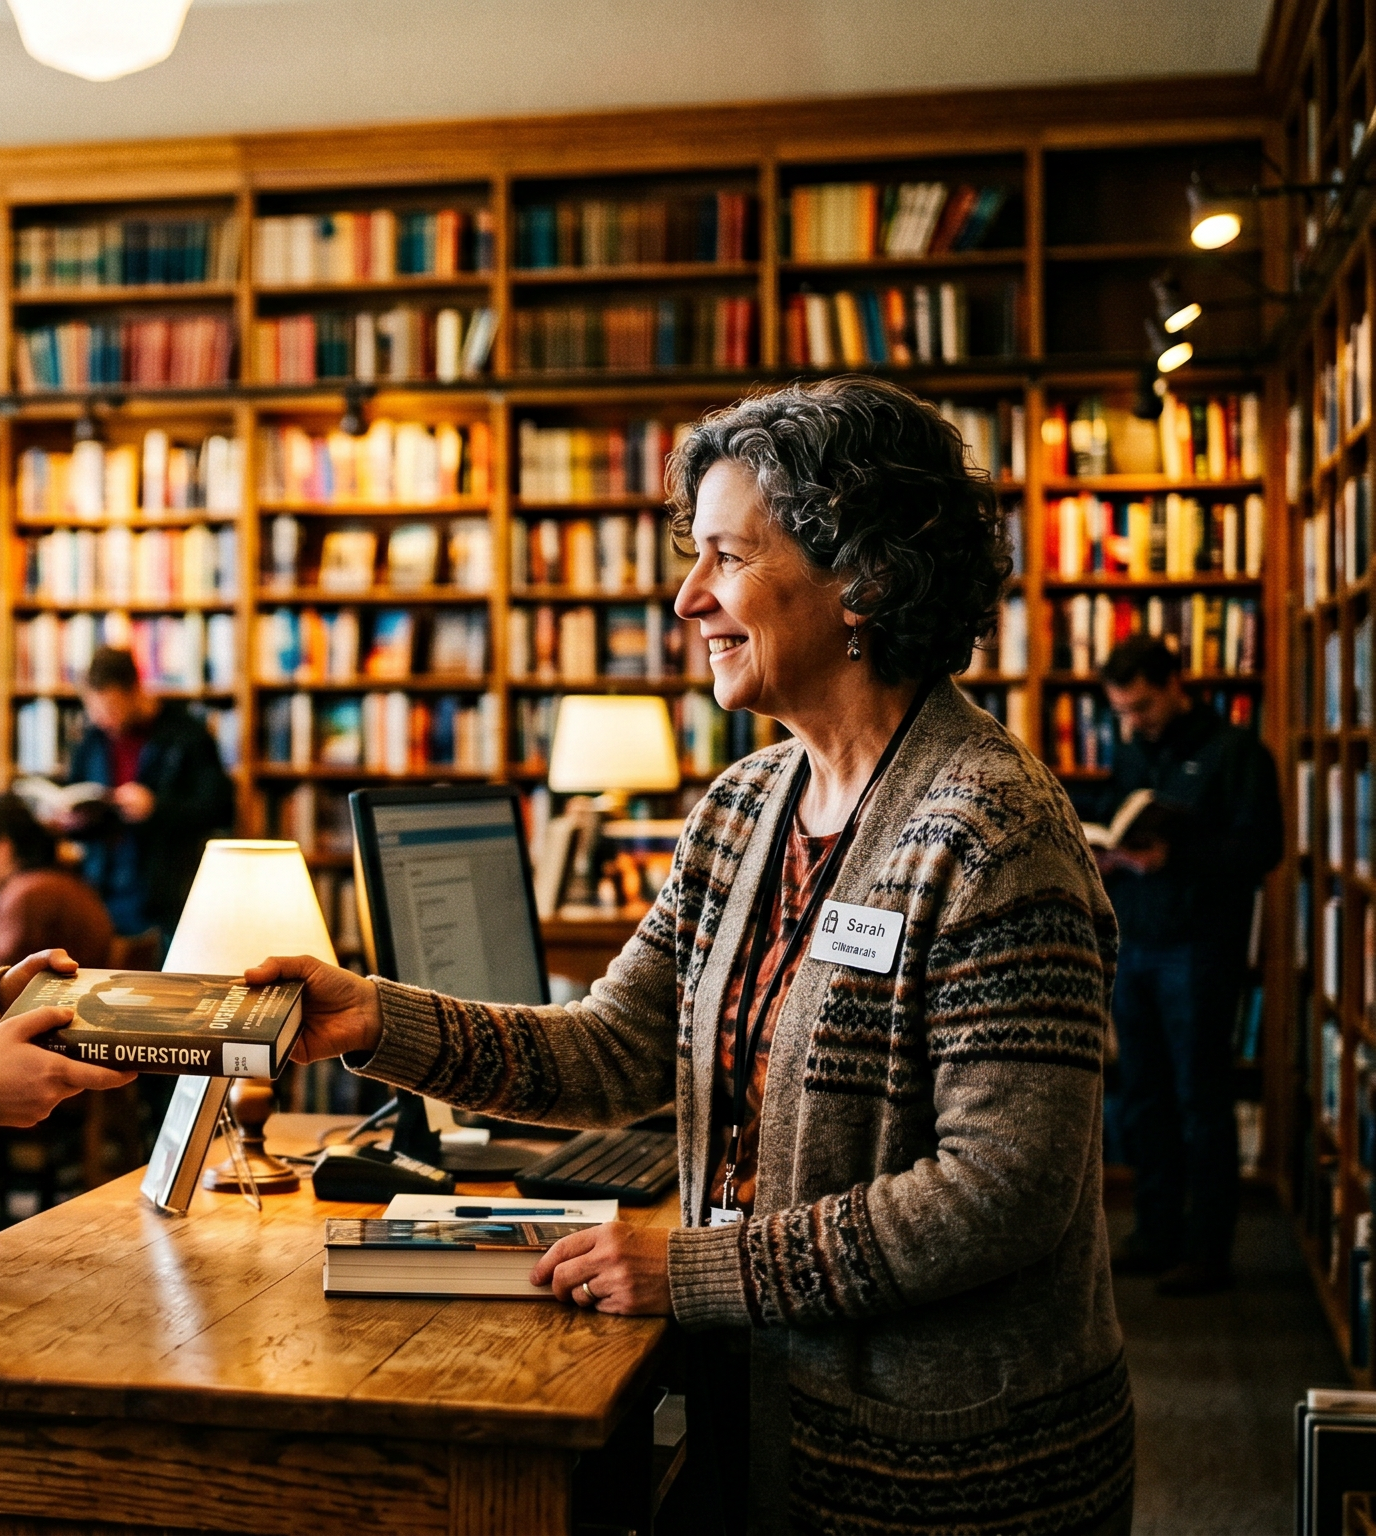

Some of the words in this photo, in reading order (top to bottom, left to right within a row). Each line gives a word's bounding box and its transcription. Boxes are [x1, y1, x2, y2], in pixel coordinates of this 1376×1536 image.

[847, 918, 885, 937] Sarah
[78, 1042, 109, 1060] THE
[115, 1045, 211, 1066] OVERSTORY
